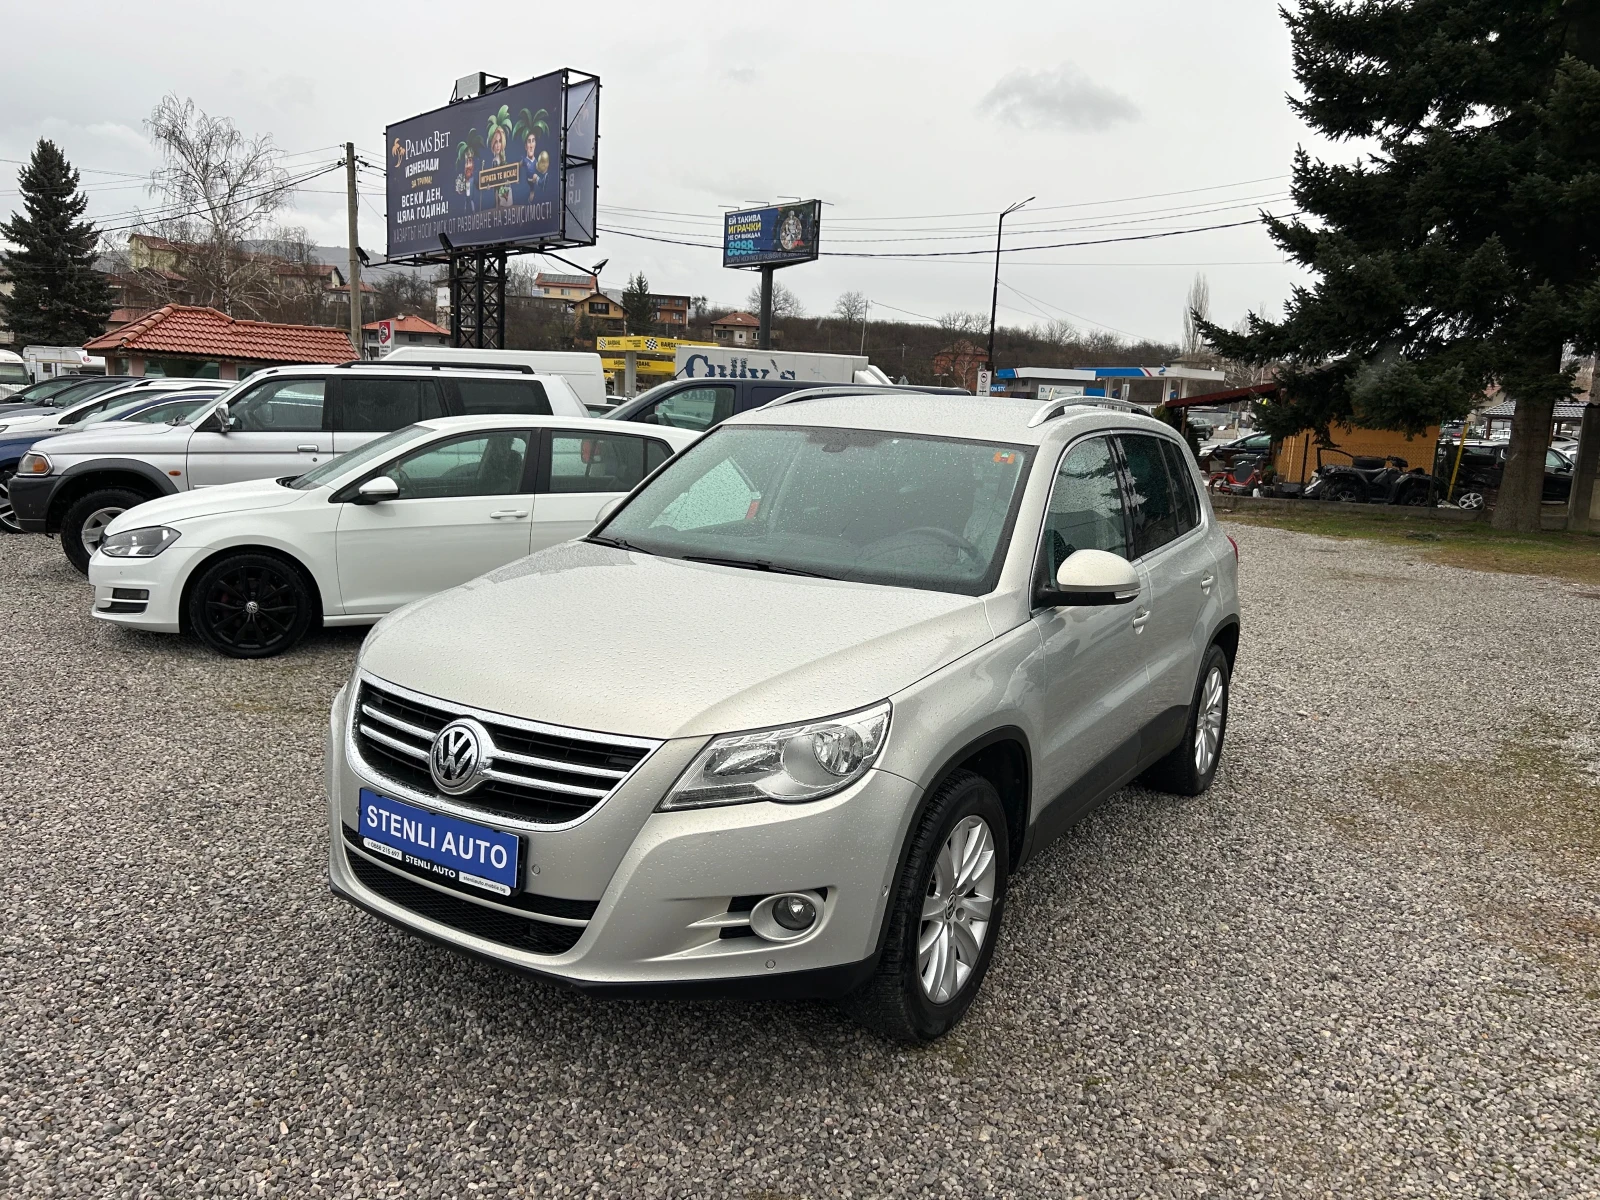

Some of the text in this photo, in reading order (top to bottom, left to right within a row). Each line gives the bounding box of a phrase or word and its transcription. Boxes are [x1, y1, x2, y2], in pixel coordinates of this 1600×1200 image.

[405, 130, 451, 160] PALMS BET
[405, 158, 440, 178] ИЗНЕНАДИ
[401, 187, 443, 208] ВСЕКИ ДЕН,
[397, 201, 449, 224] ЦЯЛА ГОДИНА!
[493, 209, 502, 227] НА
[504, 201, 552, 226] ЗАВИСИМОСТ!
[729, 213, 761, 225] ЕЙ ТАКИВА
[728, 222, 762, 234] ИГРАЧКИ
[366, 805, 507, 869] STENLI AUTO
[405, 854, 456, 878] STENLI AUTO
